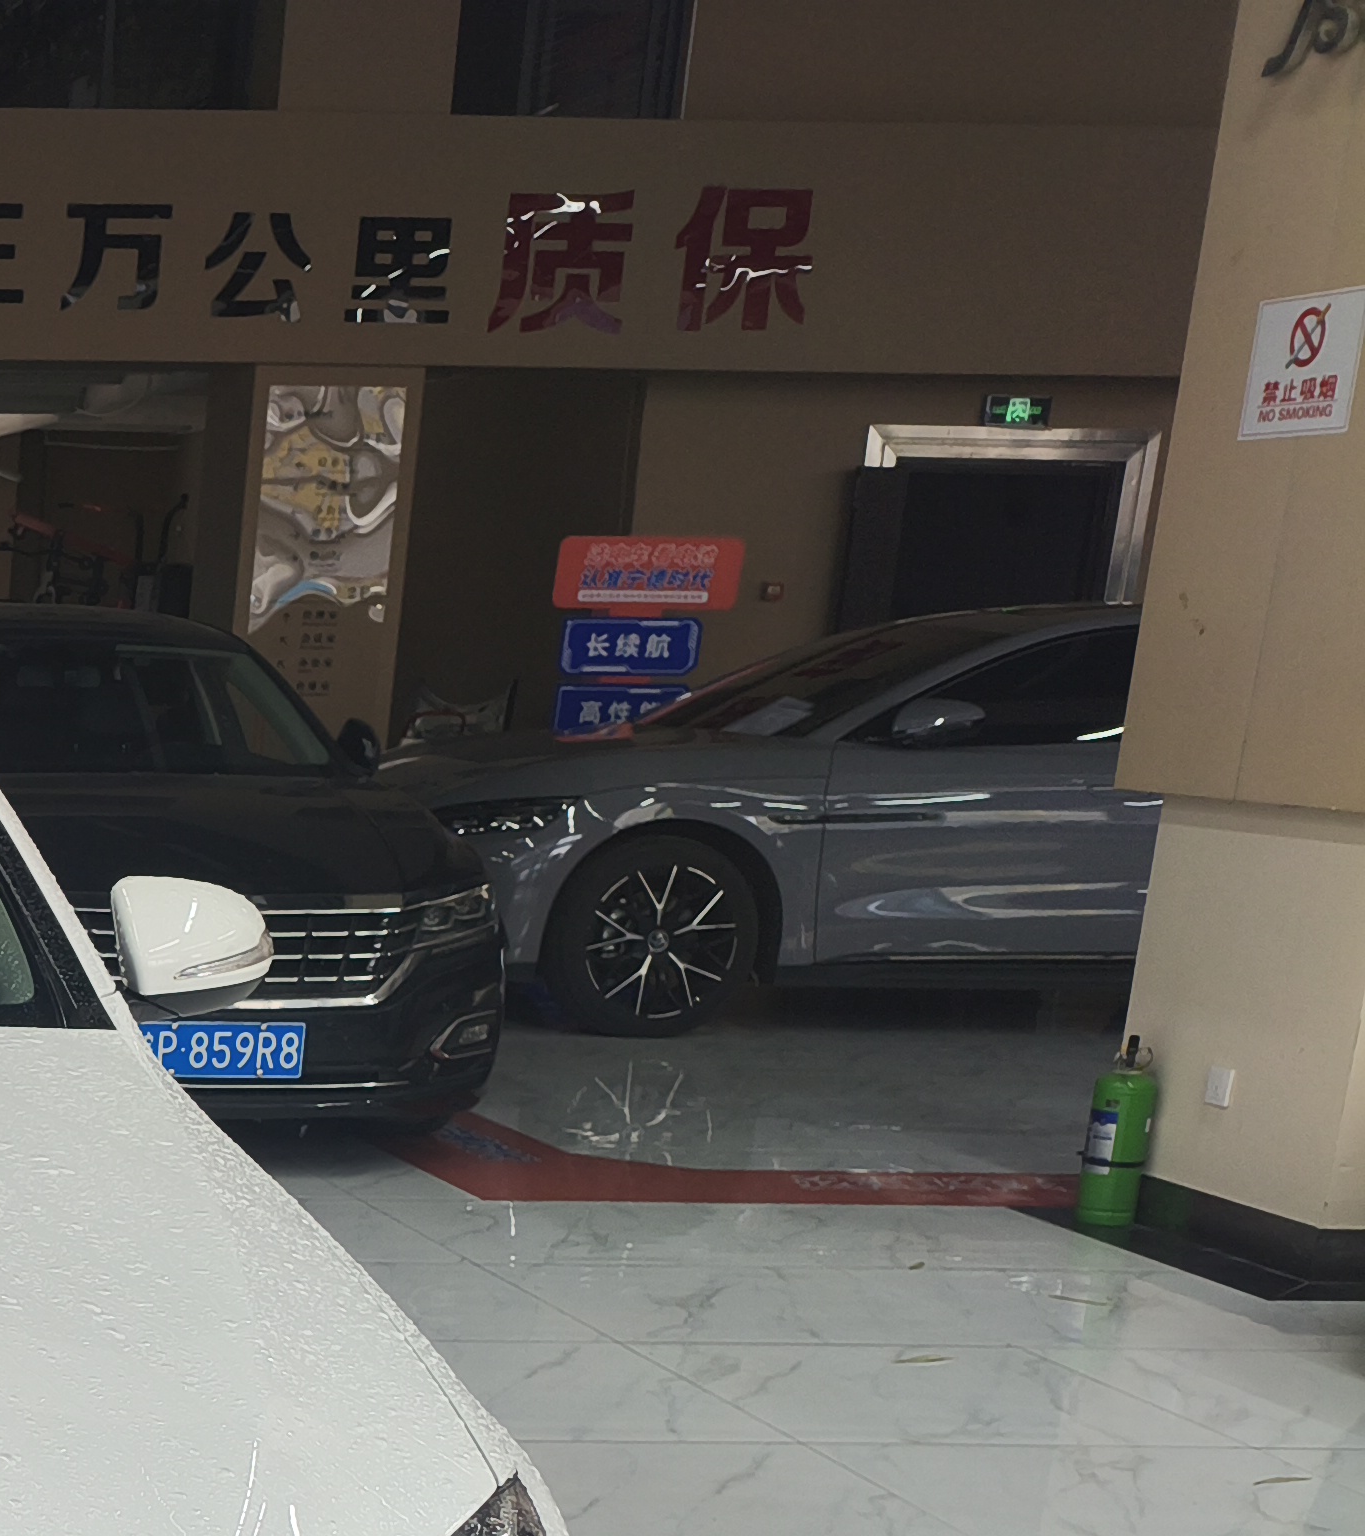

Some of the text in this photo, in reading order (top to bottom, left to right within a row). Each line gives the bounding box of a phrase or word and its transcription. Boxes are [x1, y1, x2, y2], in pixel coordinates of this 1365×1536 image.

[1261, 375, 1338, 406] 禁止吸烟
[1257, 403, 1333, 424] NO SMOKING
[586, 633, 672, 658] 长续航
[144, 1031, 300, 1069] P·859R8
